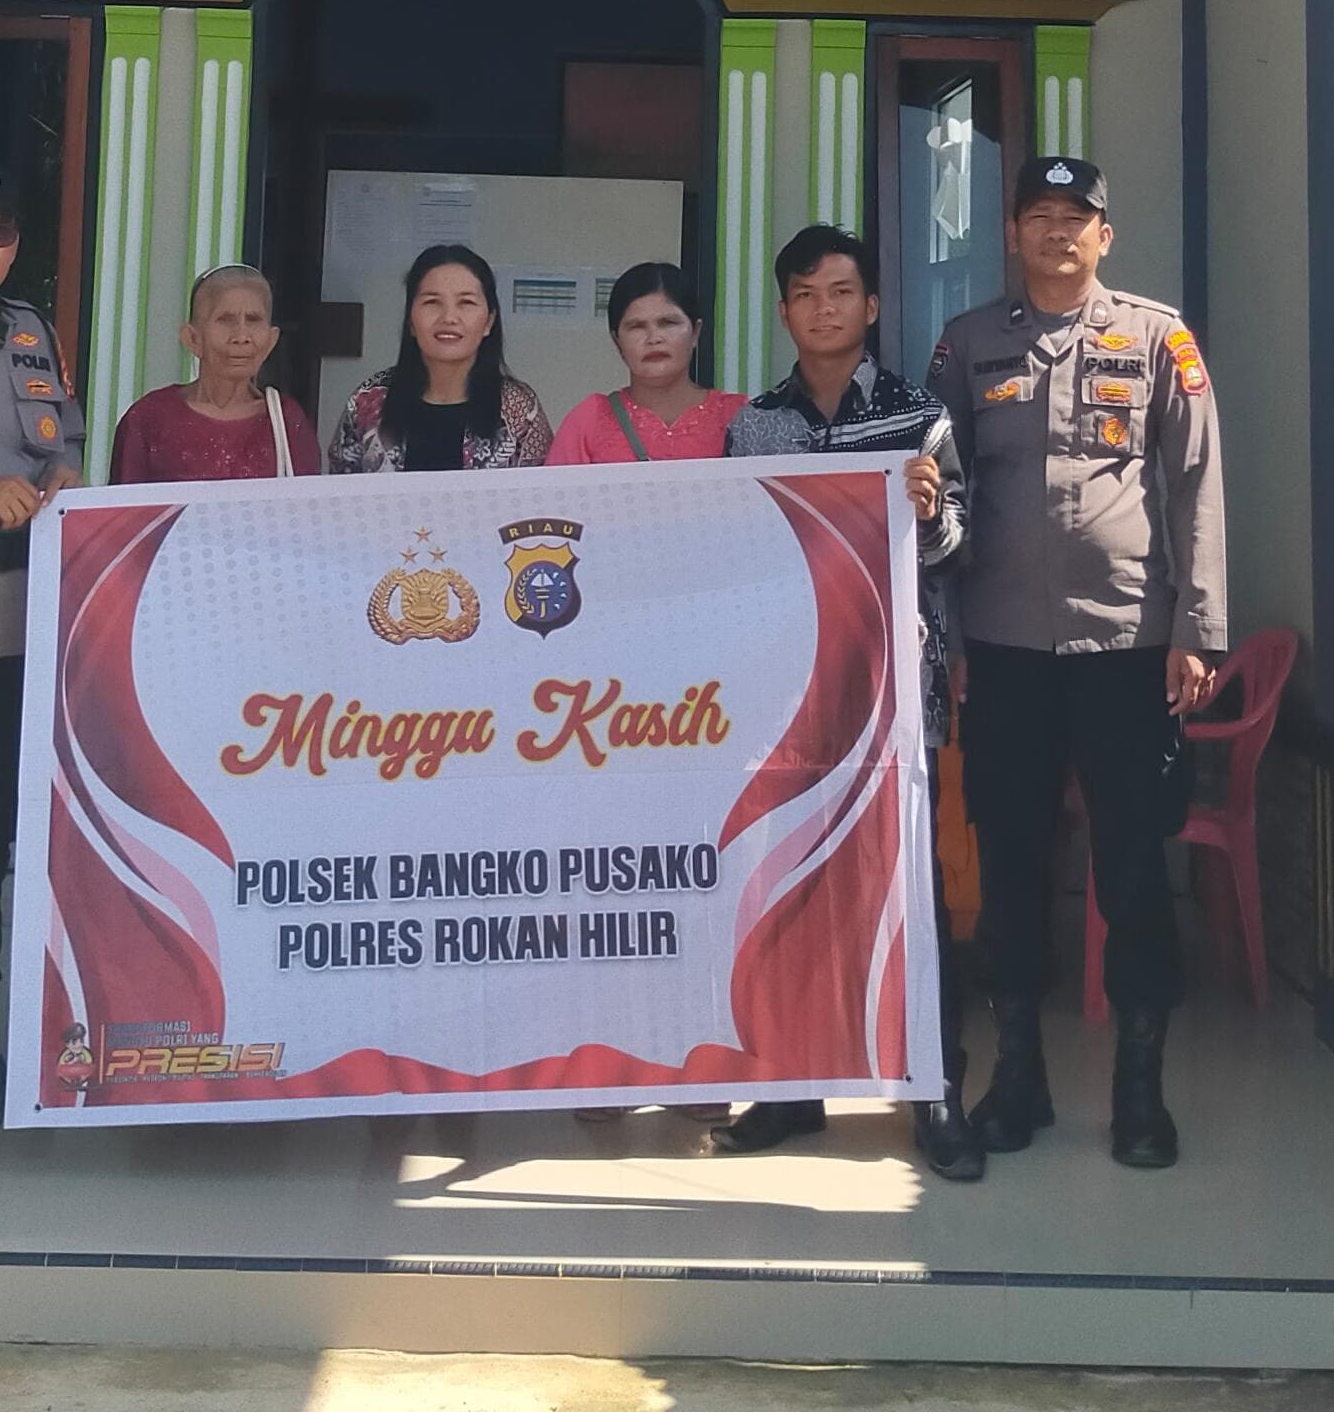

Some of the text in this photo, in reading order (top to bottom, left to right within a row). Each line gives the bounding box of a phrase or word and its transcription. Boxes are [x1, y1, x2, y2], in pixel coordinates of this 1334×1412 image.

[508, 522, 574, 539] RIAU
[221, 679, 731, 782] Minggu Kasih
[237, 843, 718, 906] POLSEK BANGKO PUSAKO
[279, 911, 677, 969] POLRES ROKAN HILIR
[105, 1043, 285, 1076] PRESISI
[190, 1032, 220, 1045] YANG
